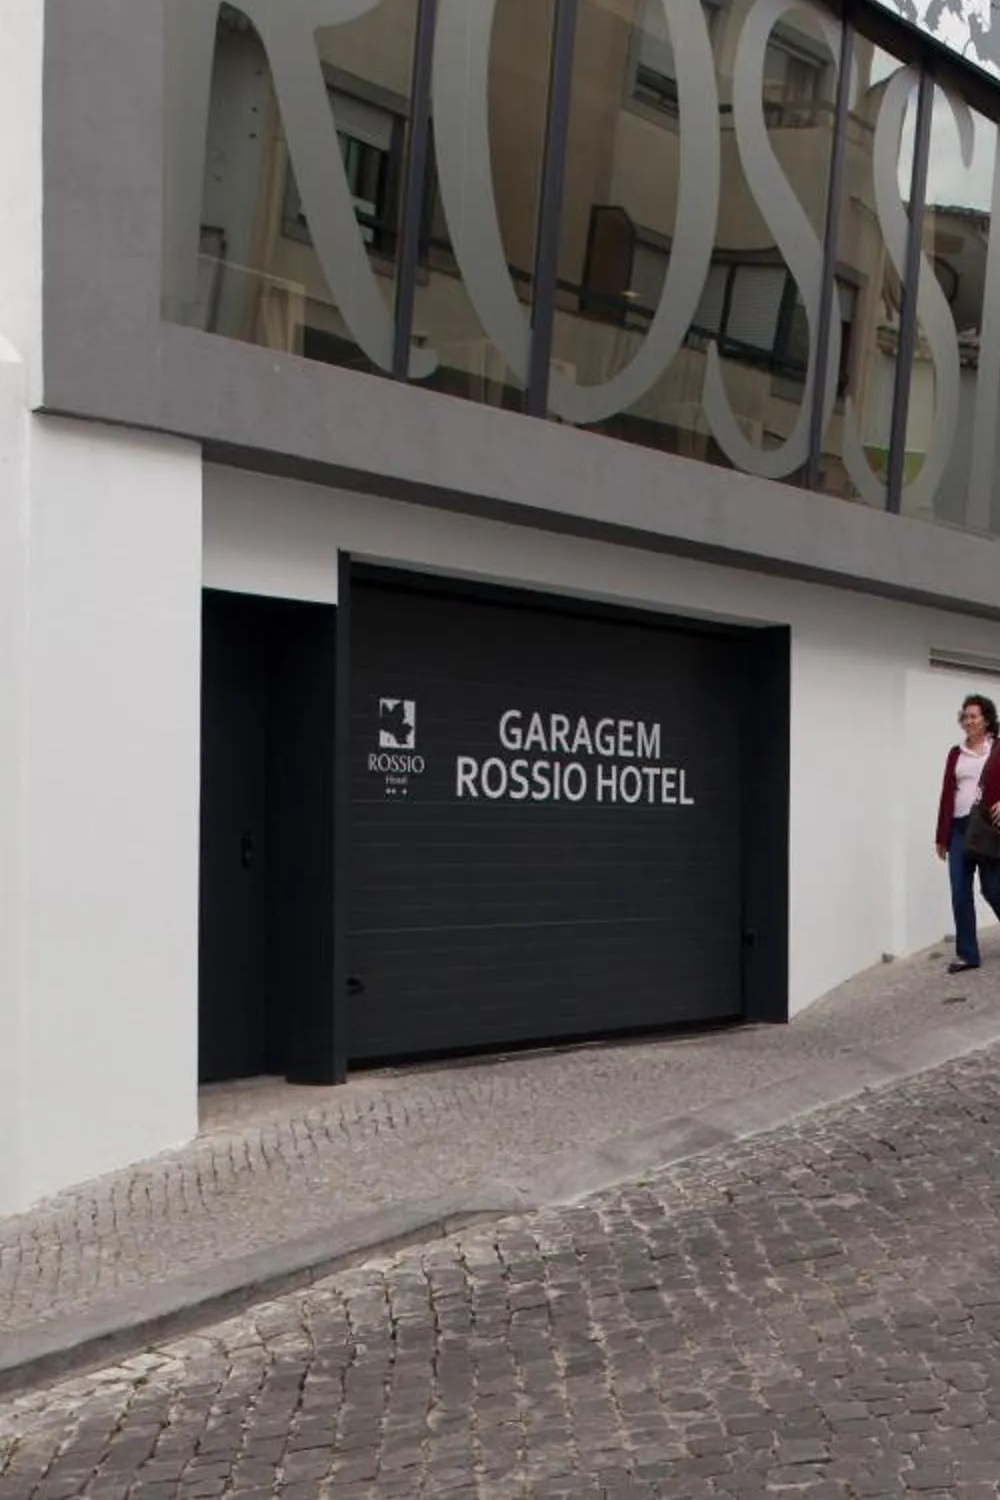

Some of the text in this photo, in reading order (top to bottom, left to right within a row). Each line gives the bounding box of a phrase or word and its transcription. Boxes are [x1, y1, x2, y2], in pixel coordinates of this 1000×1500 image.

[499, 709, 661, 759] GARAGEM
[368, 753, 425, 773] ROSSIO
[456, 755, 695, 805] ROSSIO HOTEL
